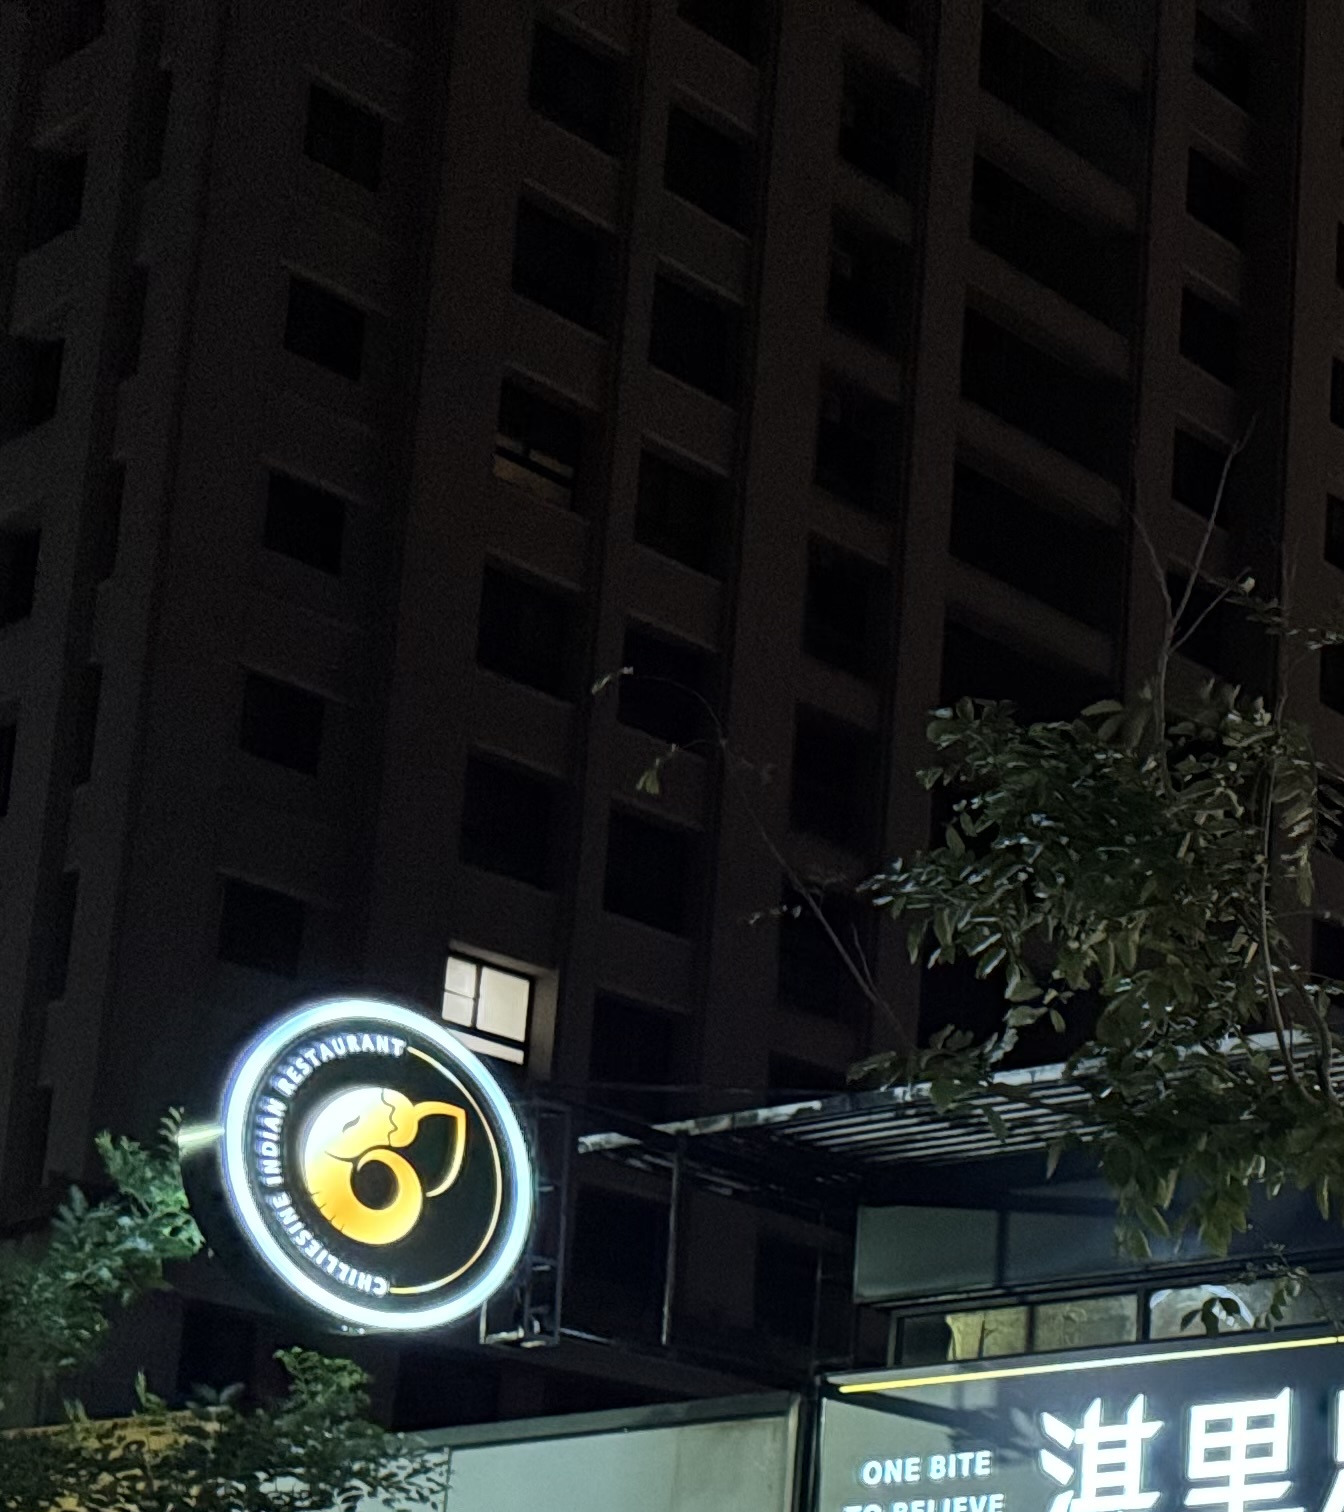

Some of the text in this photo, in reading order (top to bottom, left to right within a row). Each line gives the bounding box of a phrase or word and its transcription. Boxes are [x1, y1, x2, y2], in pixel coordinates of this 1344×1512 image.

[255, 1033, 408, 1298] CHILLIESINE INDIAN RESTAURANT
[861, 1449, 993, 1488] ONE BITE
